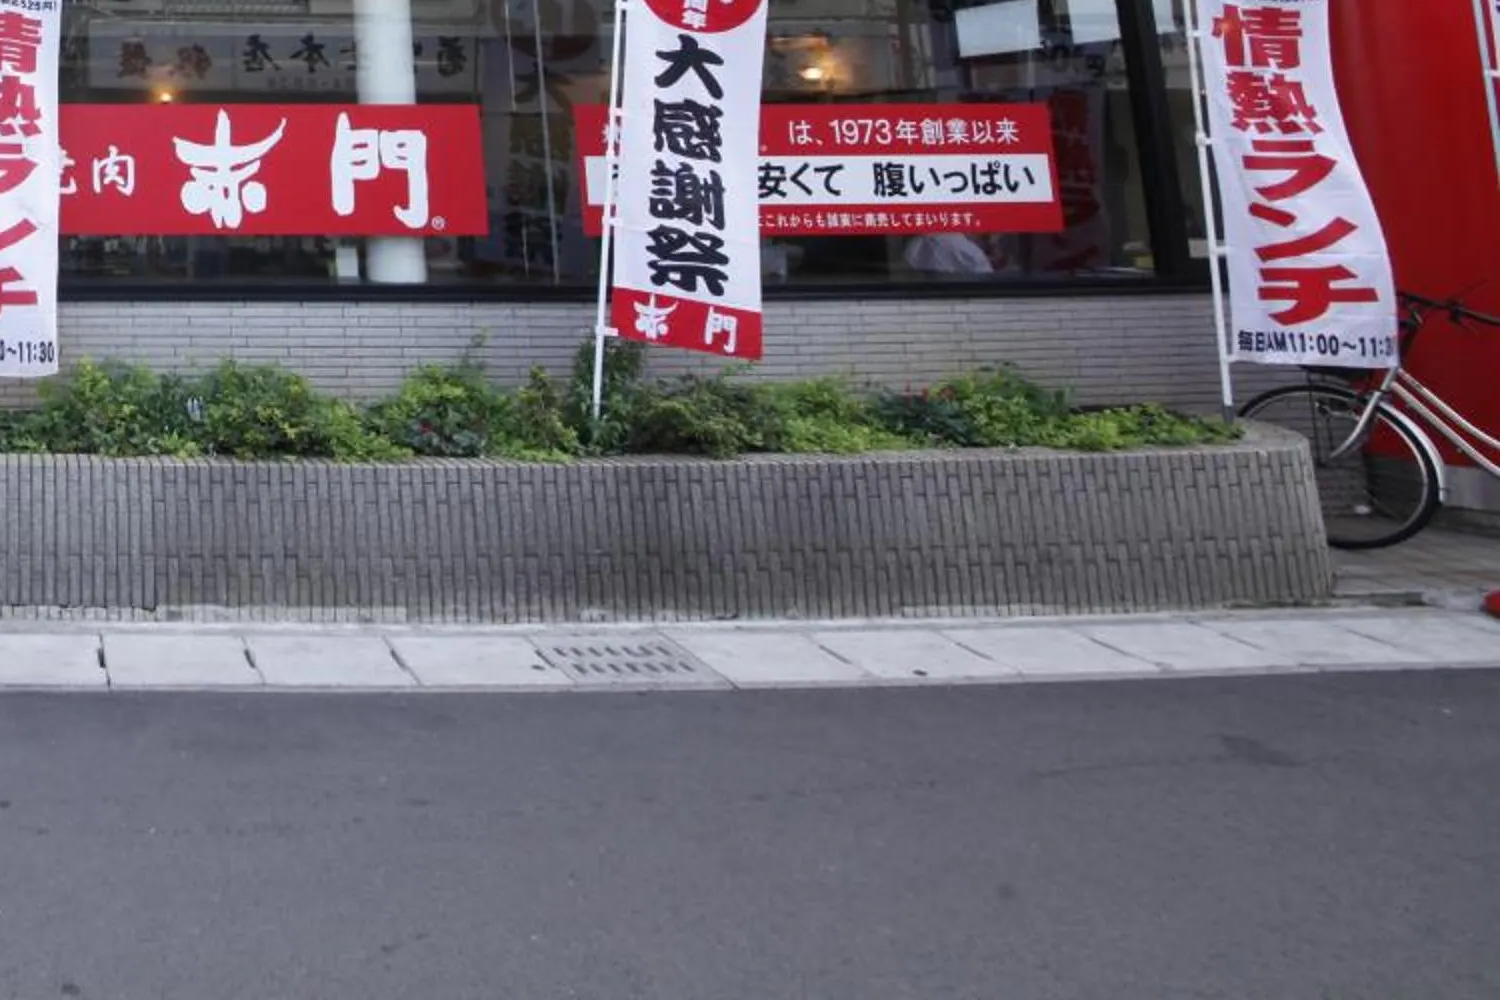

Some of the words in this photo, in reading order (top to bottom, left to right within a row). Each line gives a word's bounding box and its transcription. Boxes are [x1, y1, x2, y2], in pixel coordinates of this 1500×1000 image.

[172, 108, 429, 229] 赤門
[645, 33, 730, 296] 大感謝祭
[787, 117, 1020, 146] は、1973年創業以来
[871, 159, 1036, 198] 腹いっぱい
[1211, 3, 1379, 326] 情熱ランチ
